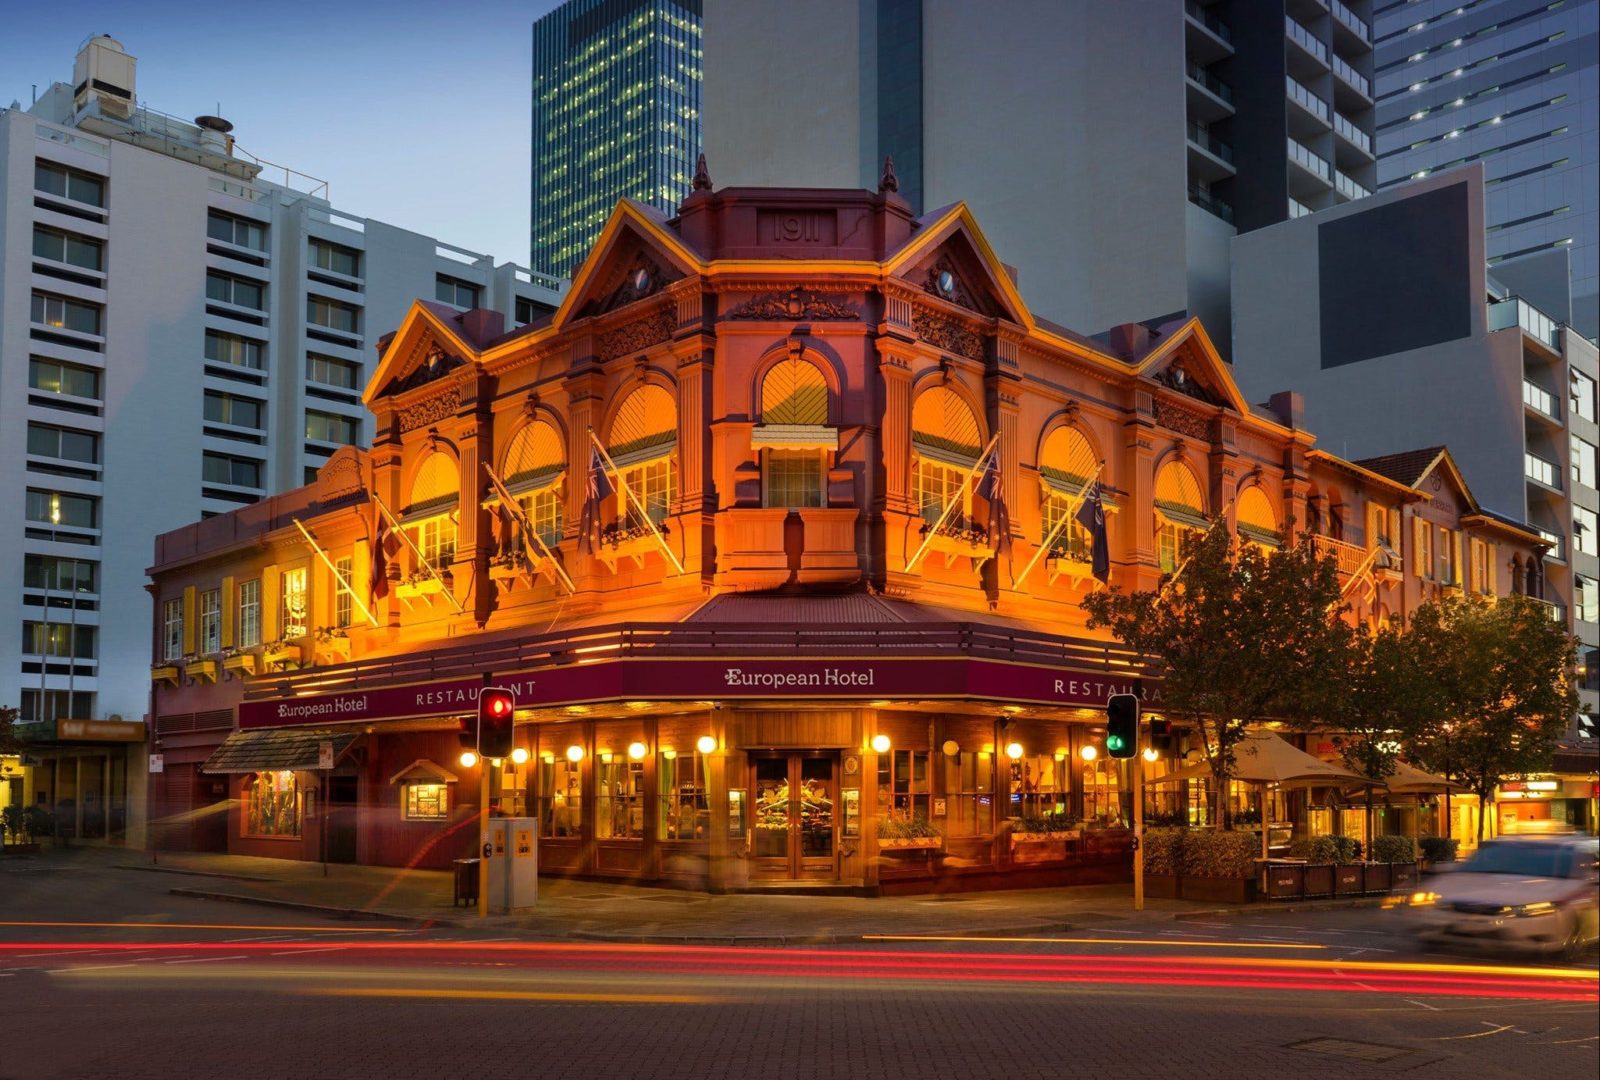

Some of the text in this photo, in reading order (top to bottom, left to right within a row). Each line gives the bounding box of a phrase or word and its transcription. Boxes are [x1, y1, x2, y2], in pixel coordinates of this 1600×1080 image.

[773, 214, 820, 242] 1911
[724, 668, 875, 689] European Hotel
[416, 681, 536, 706] RESTAUNT
[1054, 679, 1162, 702] RESTAURA
[278, 696, 367, 718] European Hotel
